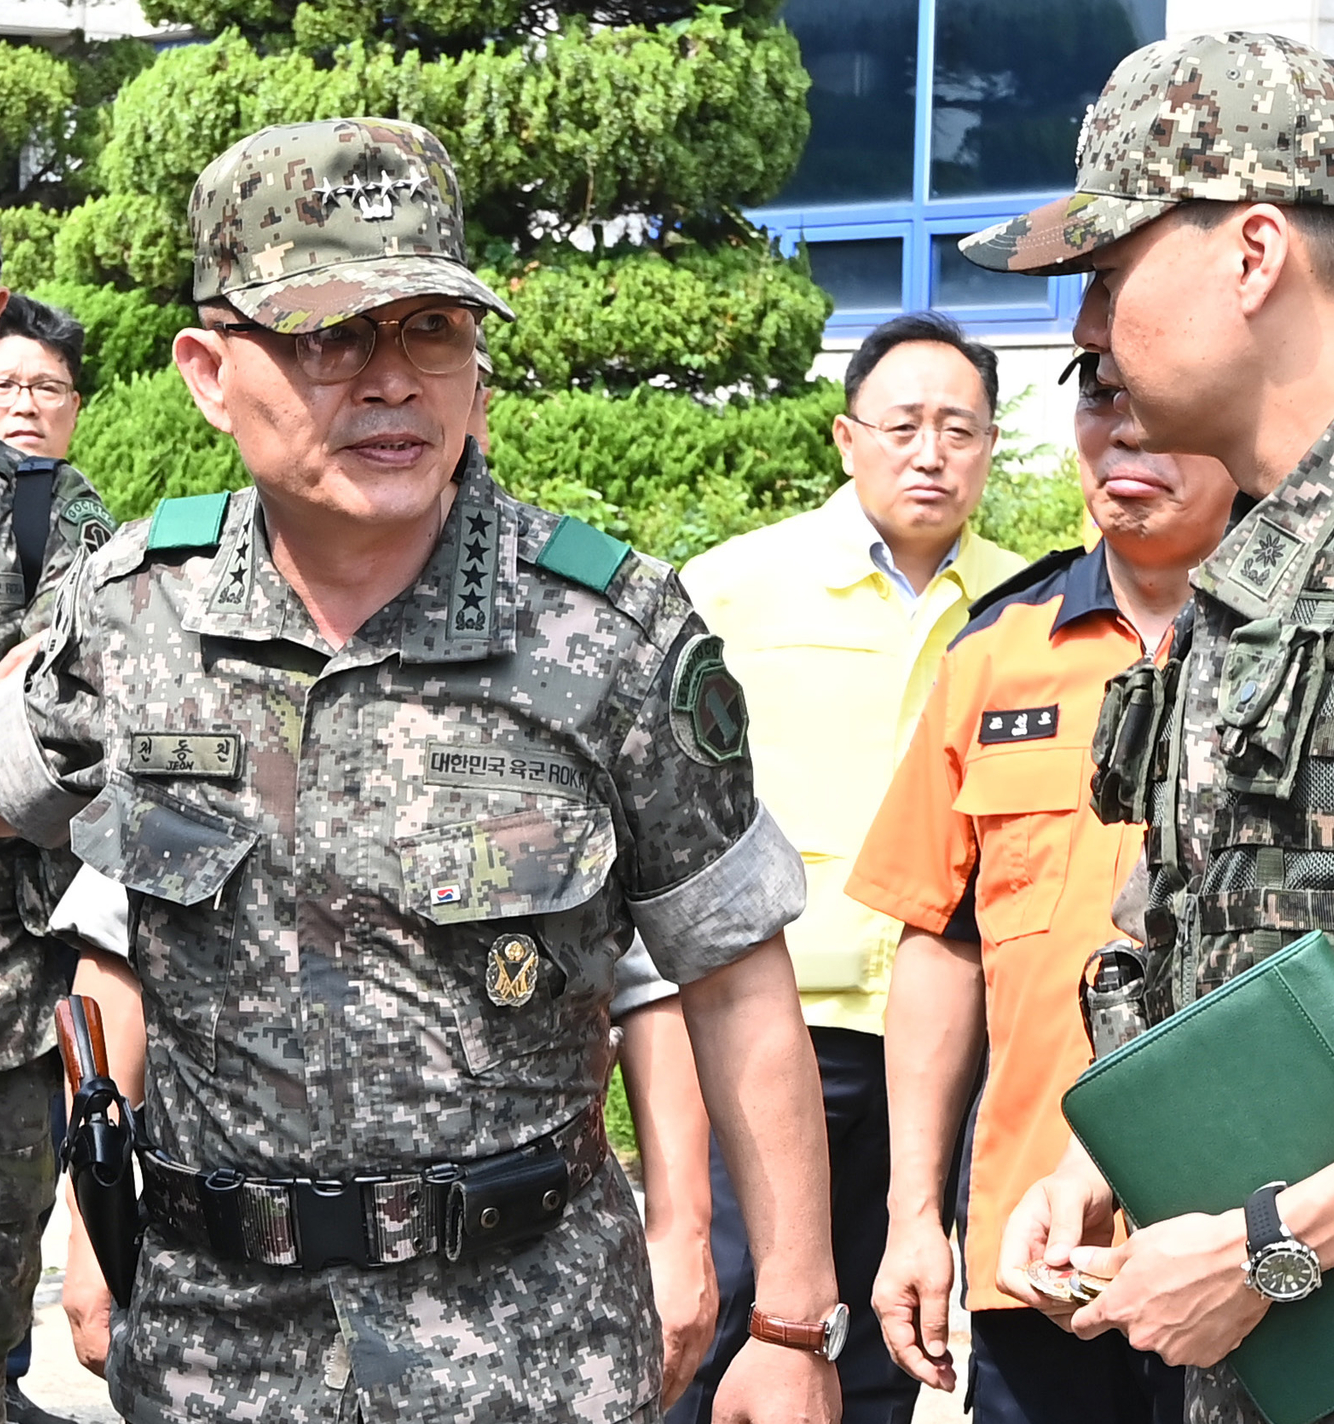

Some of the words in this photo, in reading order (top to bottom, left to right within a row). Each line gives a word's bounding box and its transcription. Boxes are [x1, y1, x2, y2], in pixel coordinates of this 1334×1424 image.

[166, 760, 195, 771] JEON
[430, 751, 506, 778] 대한민국
[509, 758, 546, 782] 육군
[548, 763, 586, 791] ROKA
